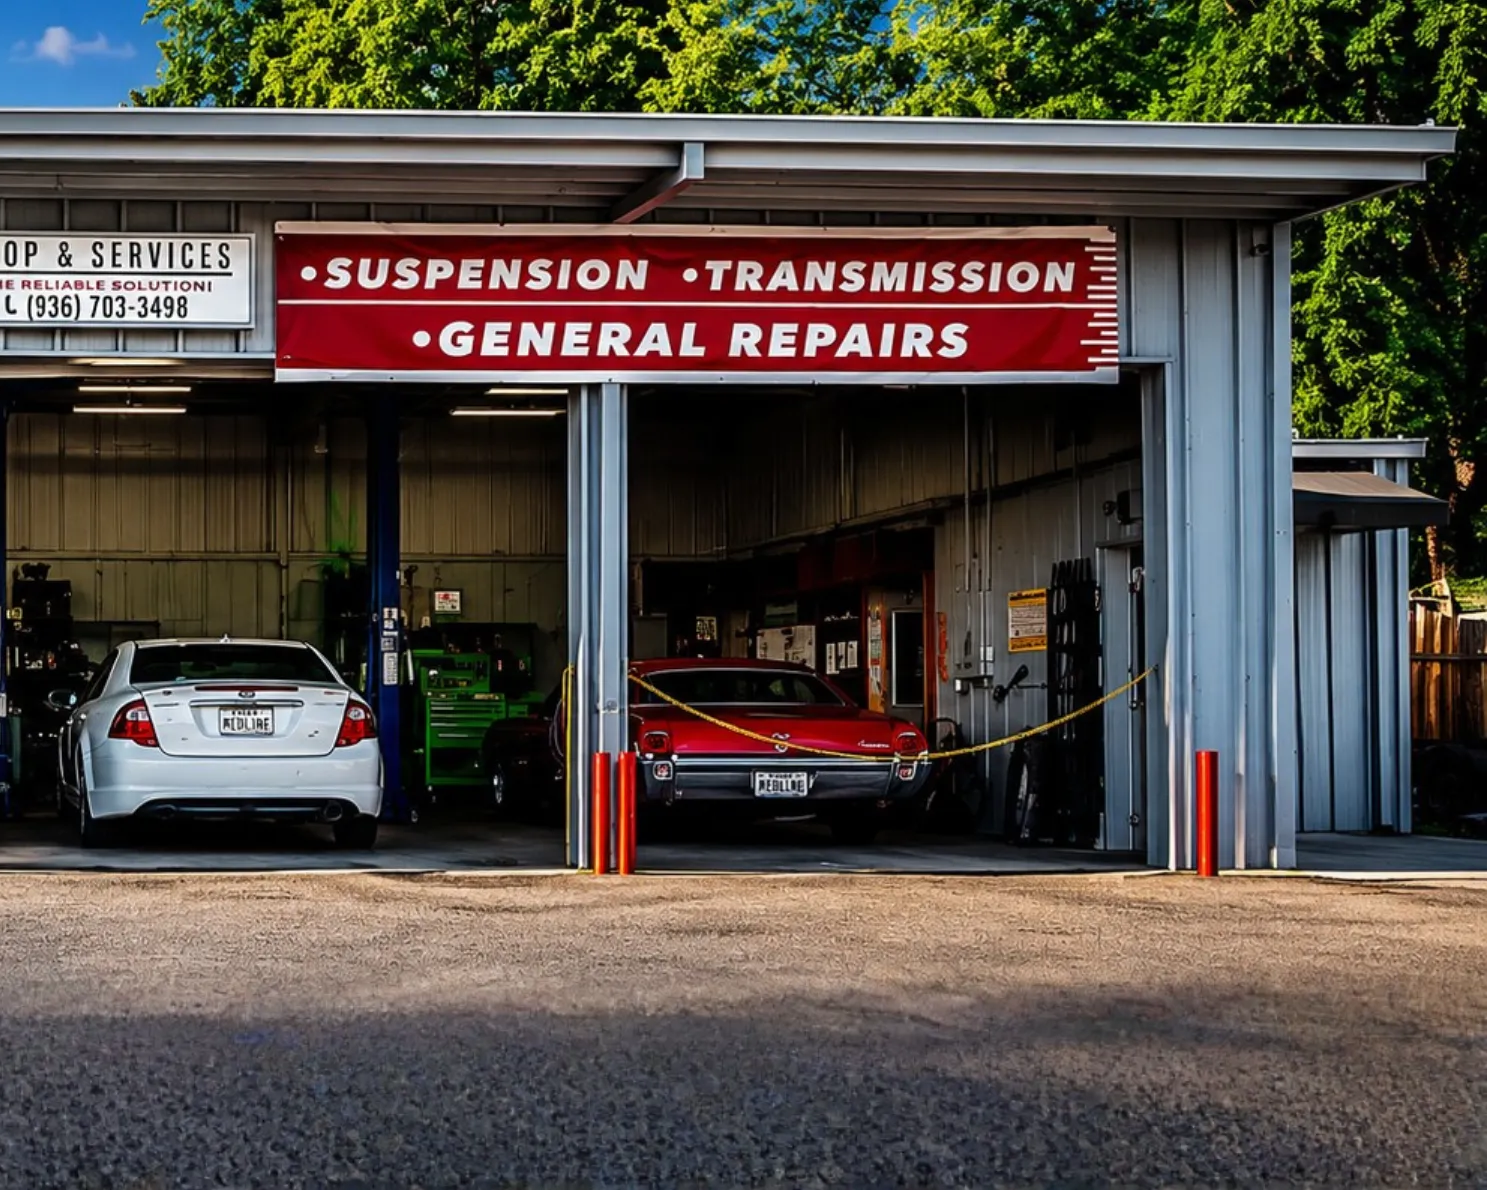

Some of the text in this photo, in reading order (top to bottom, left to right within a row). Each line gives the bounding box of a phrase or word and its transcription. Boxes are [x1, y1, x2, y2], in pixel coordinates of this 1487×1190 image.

[58, 241, 73, 267] &
[91, 242, 231, 269] SERVICES
[21, 279, 108, 291] RELIABLE
[27, 294, 188, 321] (936) 703-3498
[728, 322, 969, 358] REPAIRS
